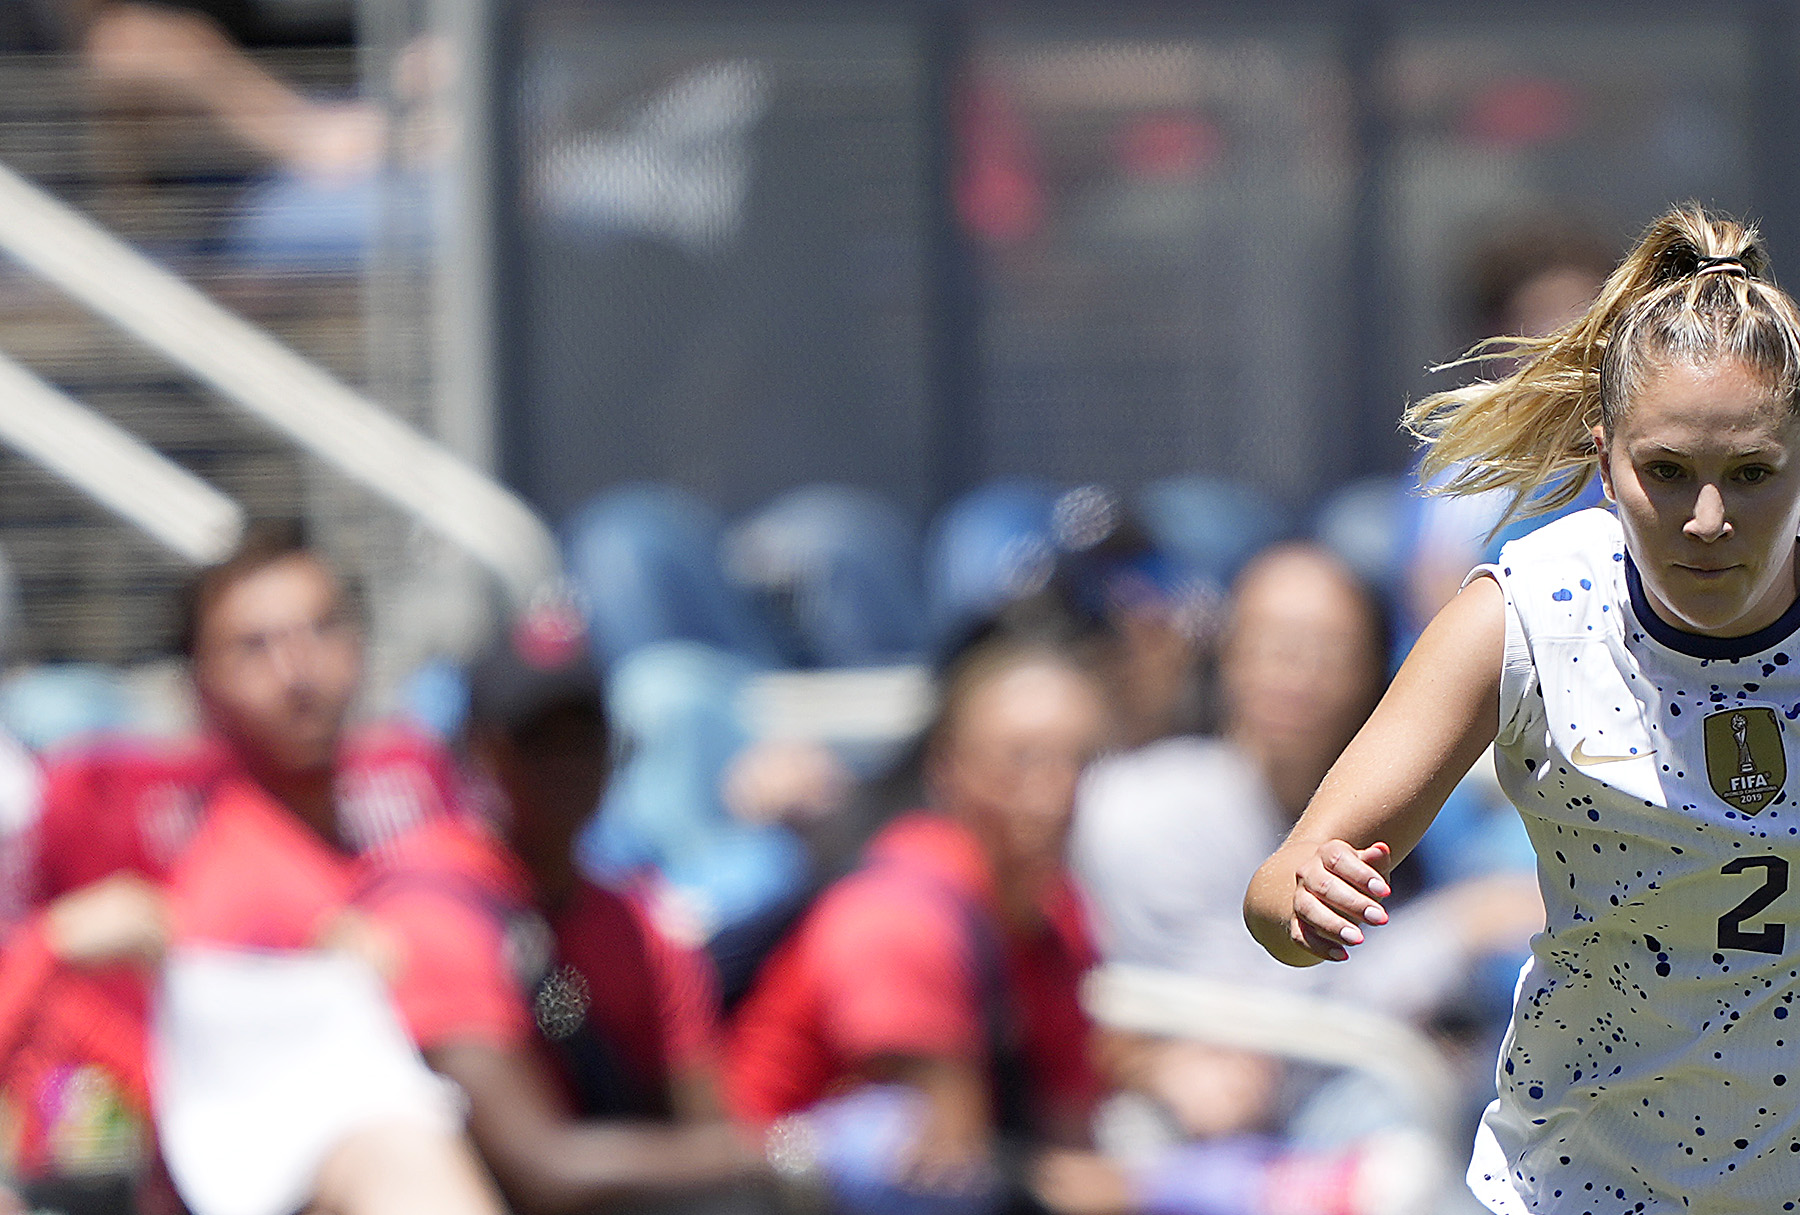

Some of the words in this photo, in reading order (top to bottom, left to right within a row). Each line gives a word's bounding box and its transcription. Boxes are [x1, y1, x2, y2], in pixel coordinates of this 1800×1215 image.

[1731, 774, 1768, 791] FIFA
[1741, 794, 1762, 803] 2019
[1718, 855, 1789, 955] 2
